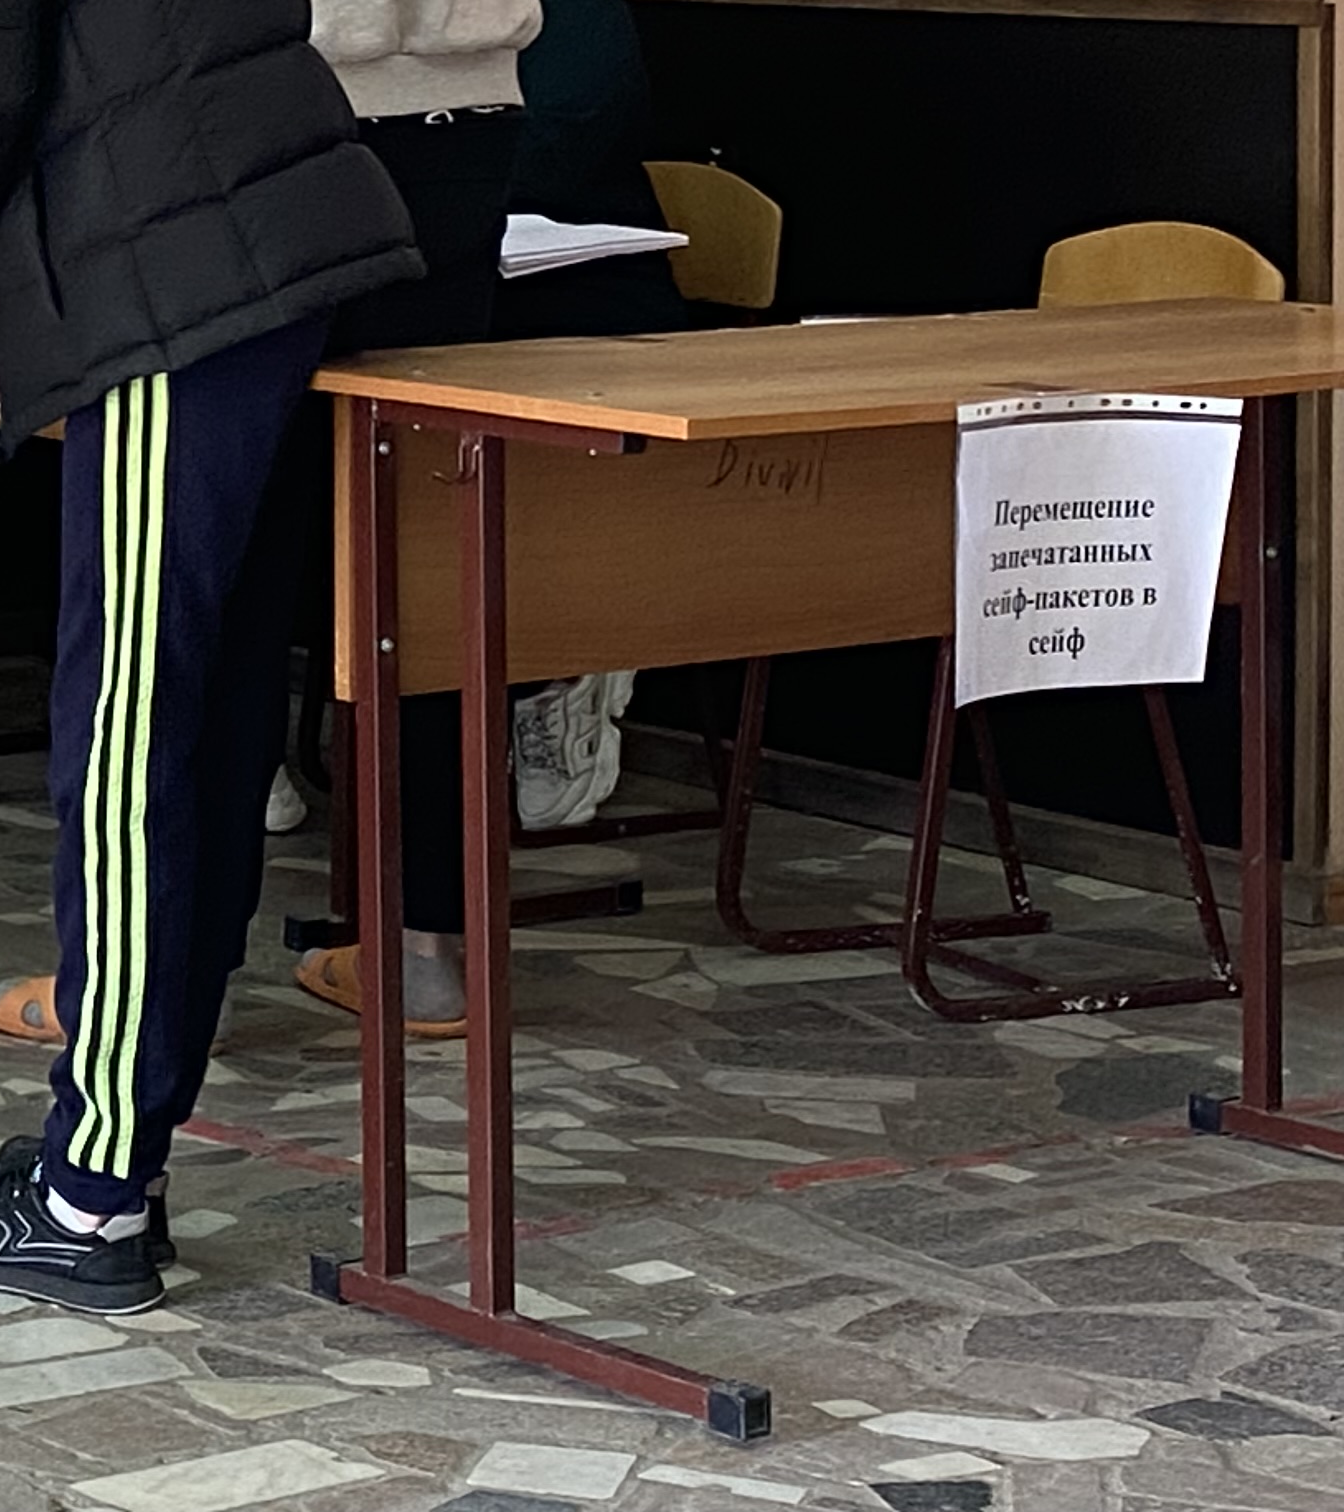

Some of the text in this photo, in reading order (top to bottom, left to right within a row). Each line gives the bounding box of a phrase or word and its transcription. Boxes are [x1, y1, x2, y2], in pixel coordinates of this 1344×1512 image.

[994, 499, 1155, 531] Перемещение
[989, 543, 1153, 572] запечатанных
[982, 587, 1158, 620] сейф-пакетов в
[1028, 626, 1086, 659] сейф
